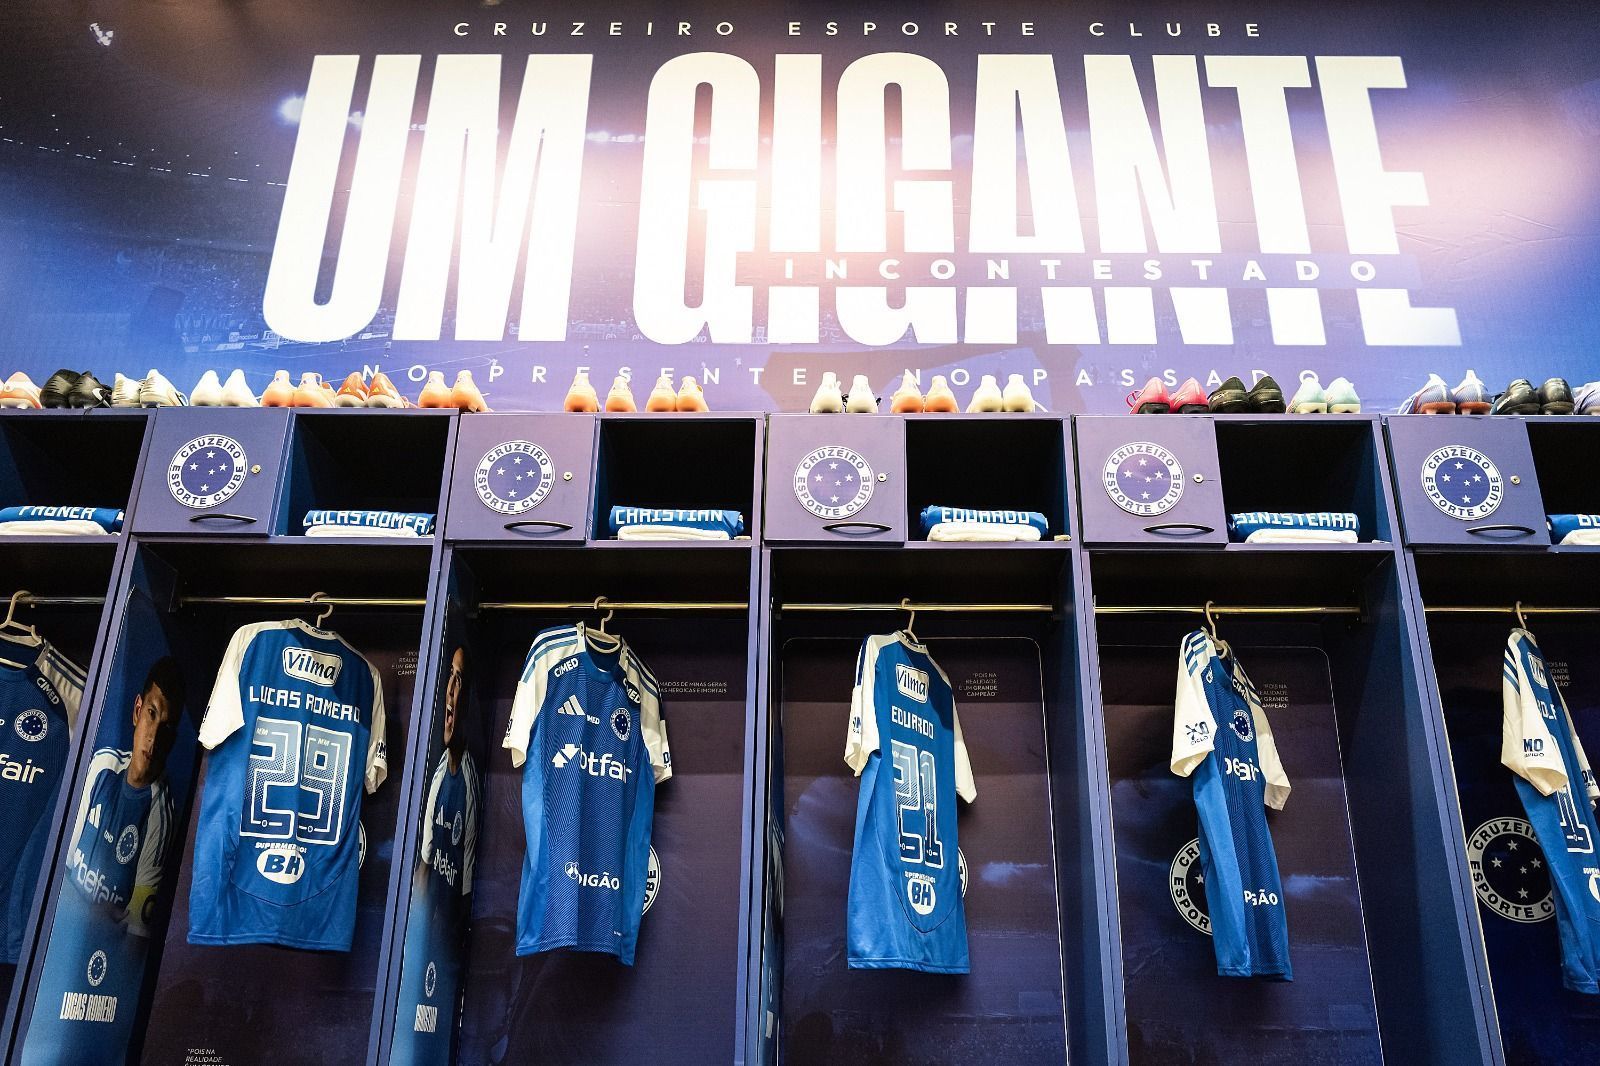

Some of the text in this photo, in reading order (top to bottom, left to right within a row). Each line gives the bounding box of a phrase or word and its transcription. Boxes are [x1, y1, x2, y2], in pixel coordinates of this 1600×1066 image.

[453, 21, 1261, 38] CRUZEIRO ESPORTE CLUBE
[262, 51, 1463, 347] UM GIGANTE
[784, 258, 1378, 282] INCONTESTADO
[362, 364, 428, 382] NO
[488, 365, 807, 385] PRESENTE
[904, 368, 970, 386] NO
[180, 437, 242, 460] CRUZEIRO
[487, 443, 549, 466] CRUZEIRO
[802, 448, 865, 470] CRUZEIRO
[1111, 445, 1175, 466] CRUZEIRO
[1428, 448, 1490, 470] CRUZEIRO
[171, 464, 244, 505] ESPORTE CLUBE
[478, 468, 552, 511] ESPORTE CLUBE
[797, 475, 871, 516] ESPORTE CLUBE
[1106, 471, 1181, 513] ESPORTE CLUBE
[1425, 476, 1500, 517] ESPORTE CLUBE
[614, 508, 724, 525] CHRISTIAN
[940, 507, 1030, 525] EDUARDO
[287, 651, 336, 681] Vilma
[553, 657, 580, 678] CIMED
[36, 677, 60, 705] CIMED
[895, 669, 927, 700] Vilma
[249, 685, 361, 724] LUCAS ROMERO
[891, 704, 935, 740] EDUARDO
[239, 715, 353, 847] 29
[890, 738, 944, 870] 21
[1472, 821, 1537, 851] CRUZEI
[263, 853, 301, 876] BH
[911, 881, 932, 906] BH
[1173, 876, 1210, 929] ESPOR
[1469, 860, 1535, 919] ESPORTE
